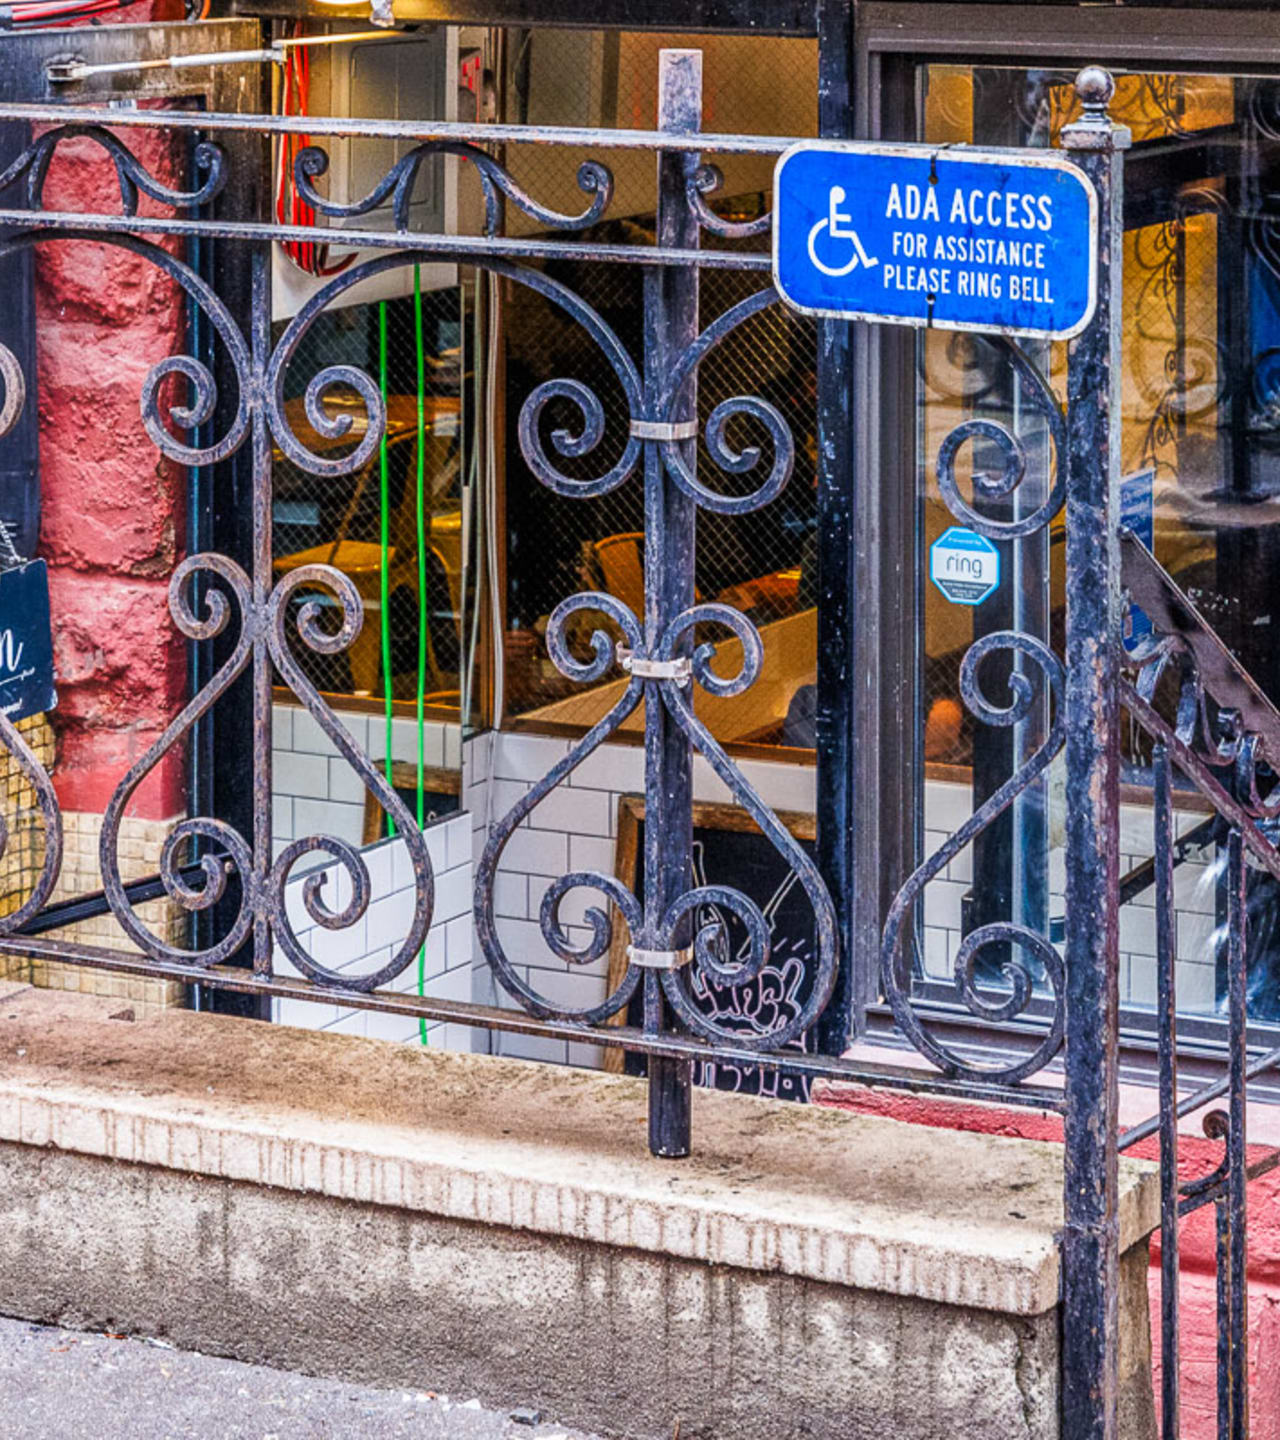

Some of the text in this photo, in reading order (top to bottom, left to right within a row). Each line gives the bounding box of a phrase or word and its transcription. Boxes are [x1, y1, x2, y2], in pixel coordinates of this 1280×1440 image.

[885, 183, 1053, 232] ADA ACCESS
[892, 231, 1046, 270] FOR ASSISTANCE
[883, 264, 1055, 305] PLEASE RING BELL
[946, 553, 982, 579] ring
